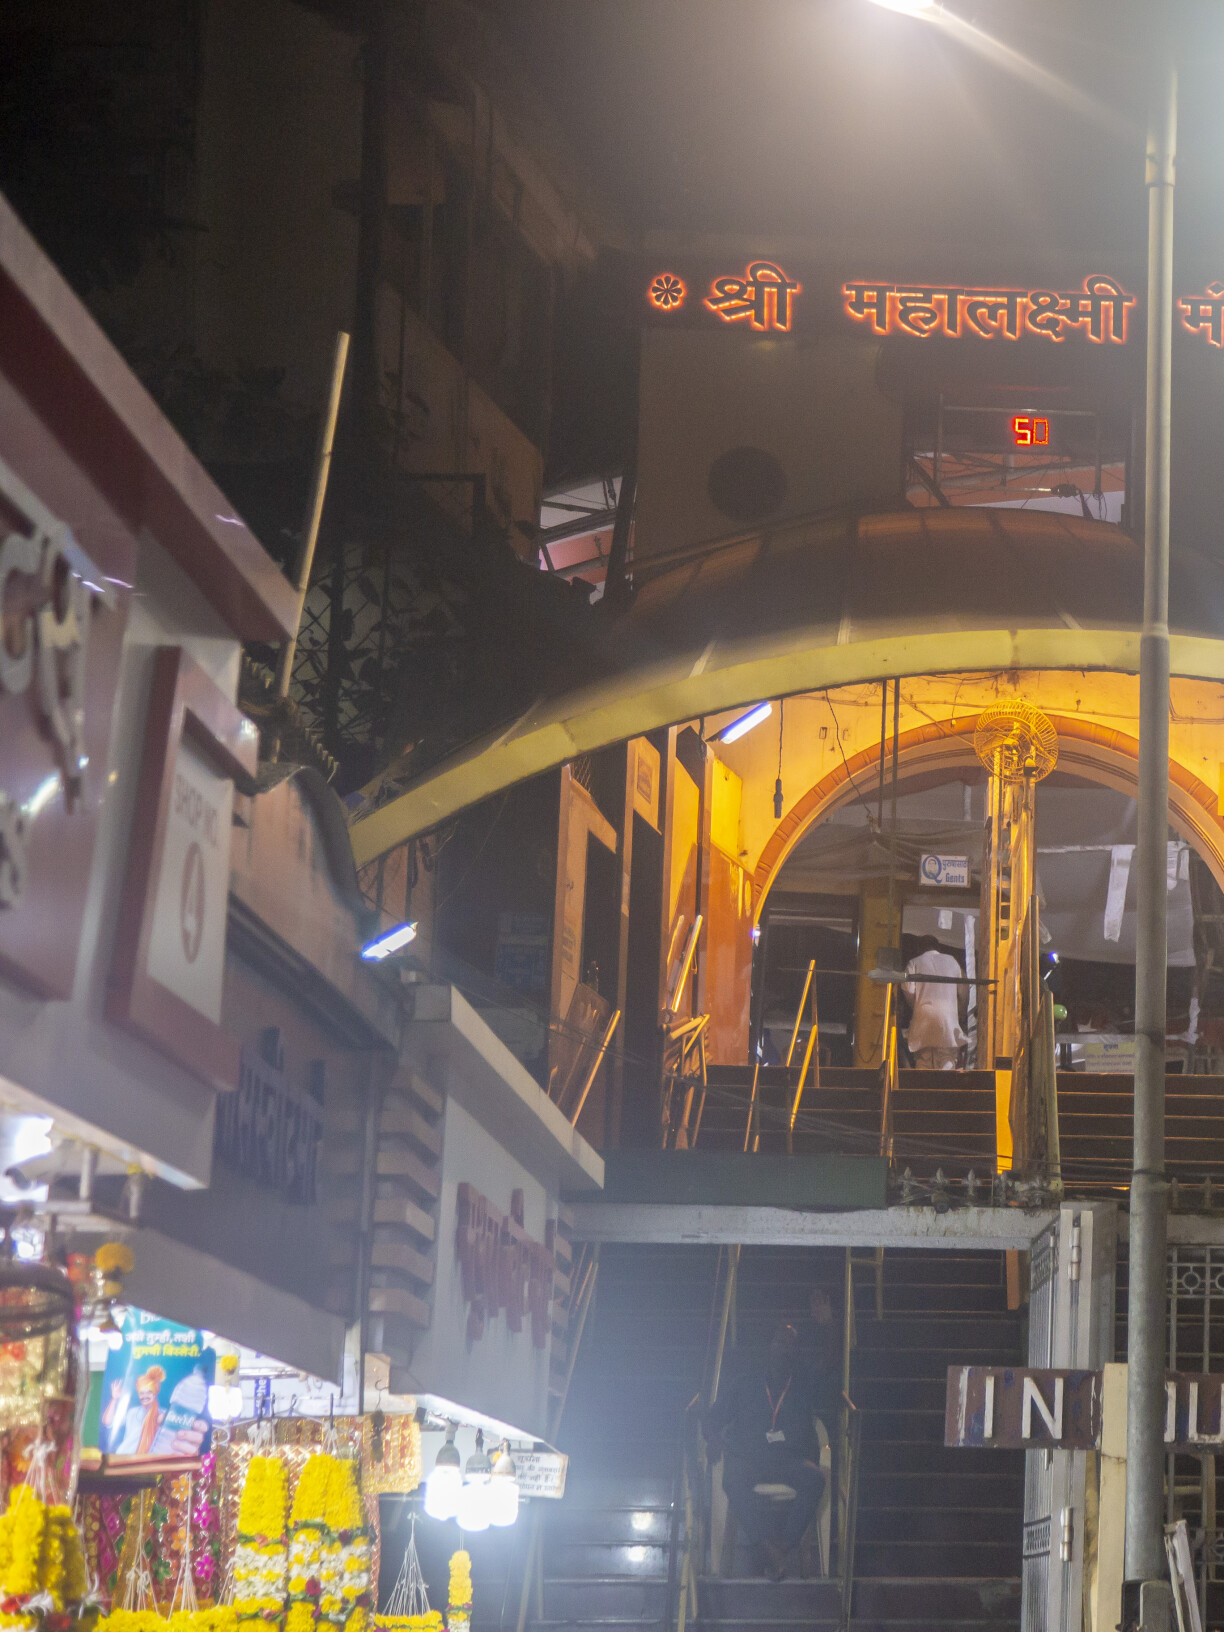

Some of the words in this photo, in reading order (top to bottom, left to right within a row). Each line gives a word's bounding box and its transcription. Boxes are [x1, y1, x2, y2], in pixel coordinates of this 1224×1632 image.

[703, 261, 800, 332] श्री
[843, 274, 1134, 344] महालक्ष्मी
[1013, 417, 1049, 446] 50
[945, 872, 965, 883] Gents
[984, 1375, 1064, 1440] IN
